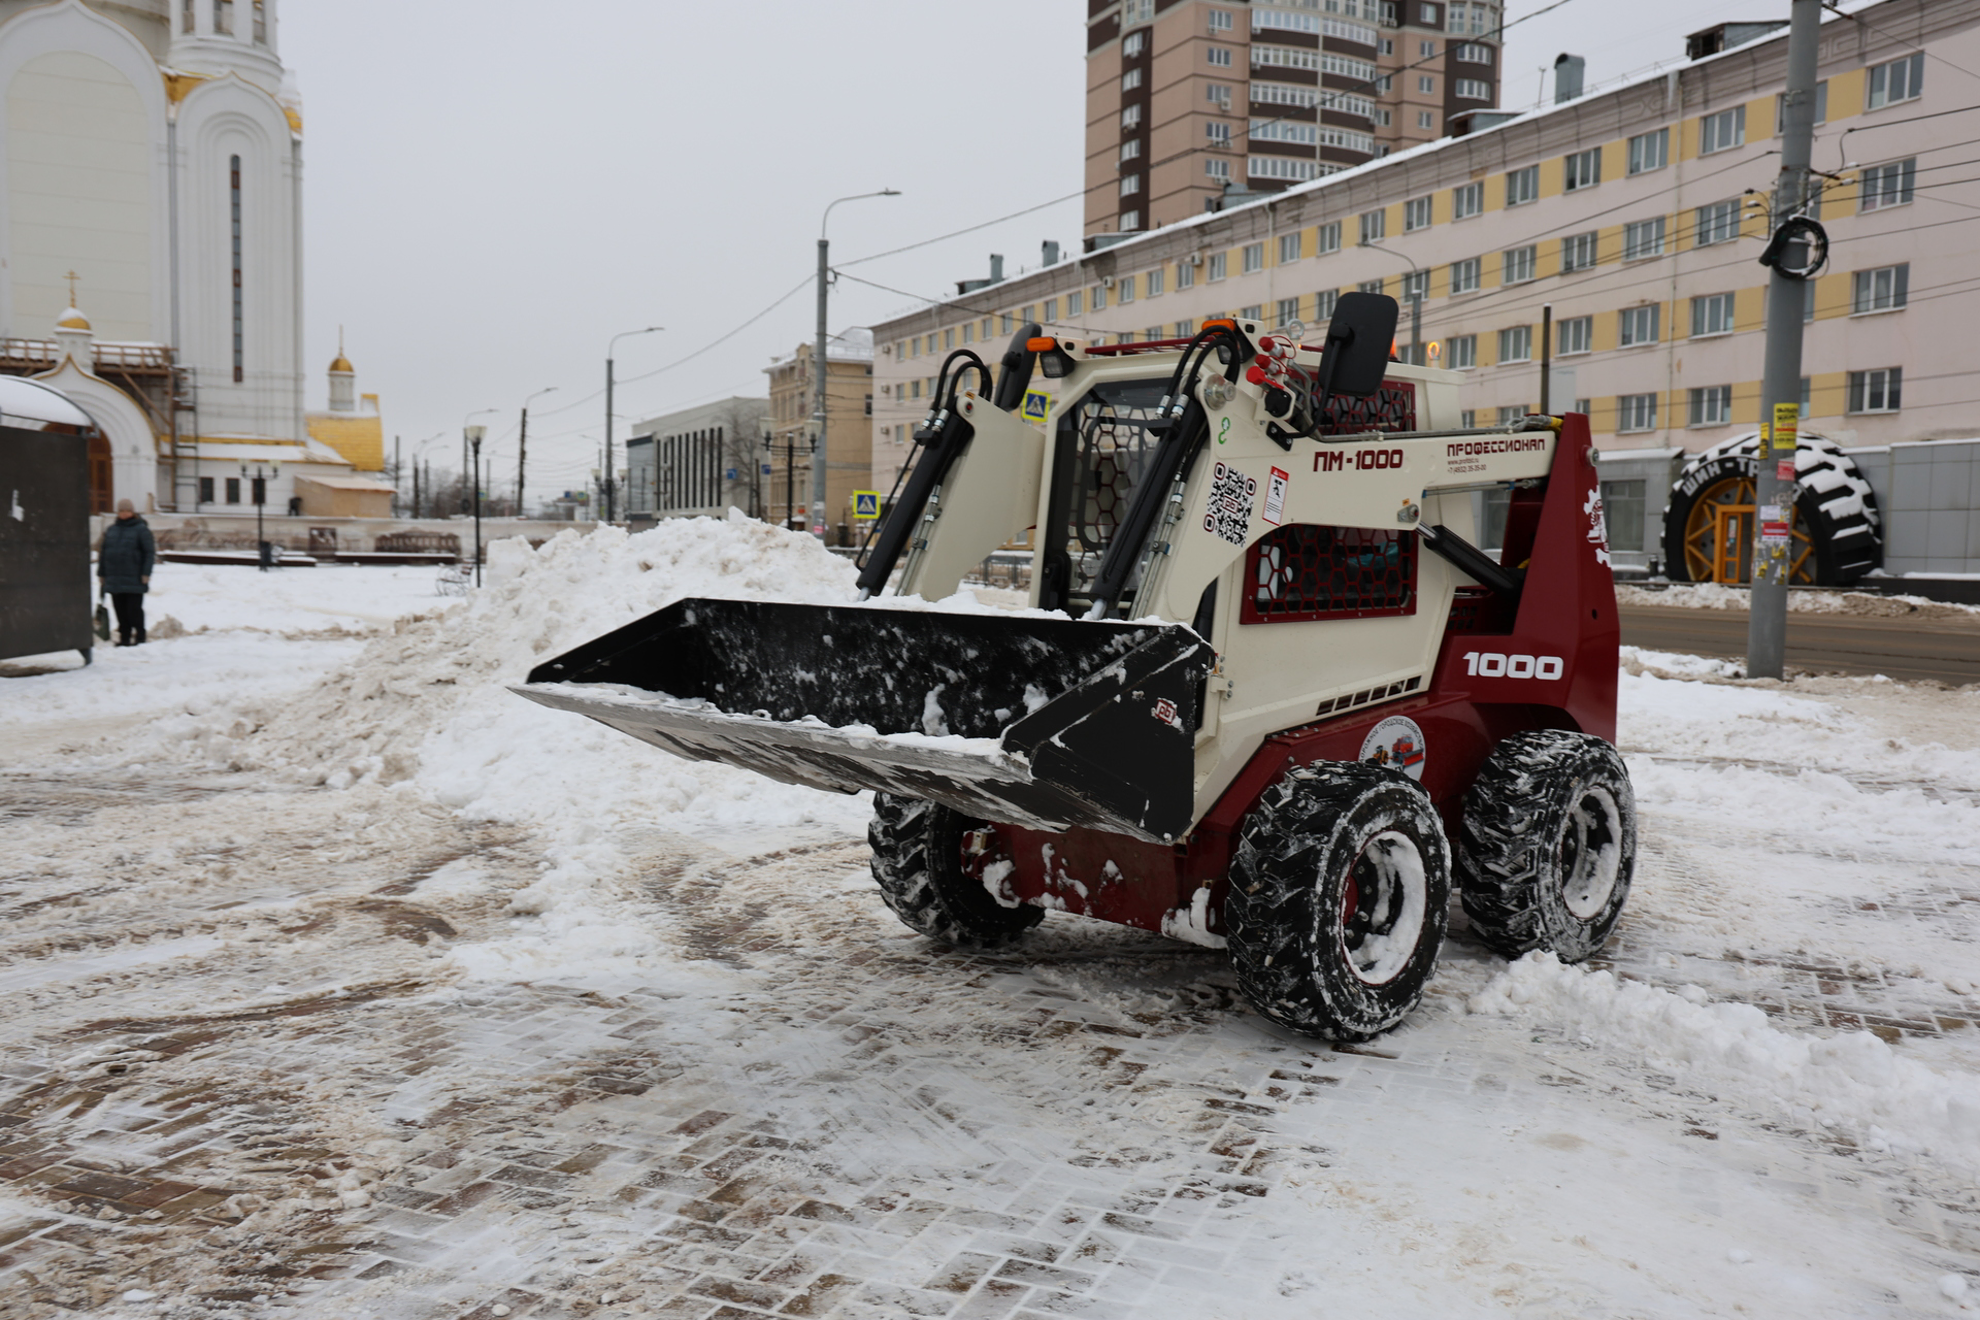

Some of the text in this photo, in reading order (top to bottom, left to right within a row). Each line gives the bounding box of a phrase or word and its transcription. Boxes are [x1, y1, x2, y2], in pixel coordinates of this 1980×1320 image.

[1447, 439, 1545, 457] ПРОФЕССИОНАЛ
[1313, 449, 1403, 472] ПМ-1000
[1462, 652, 1564, 681] 1000
